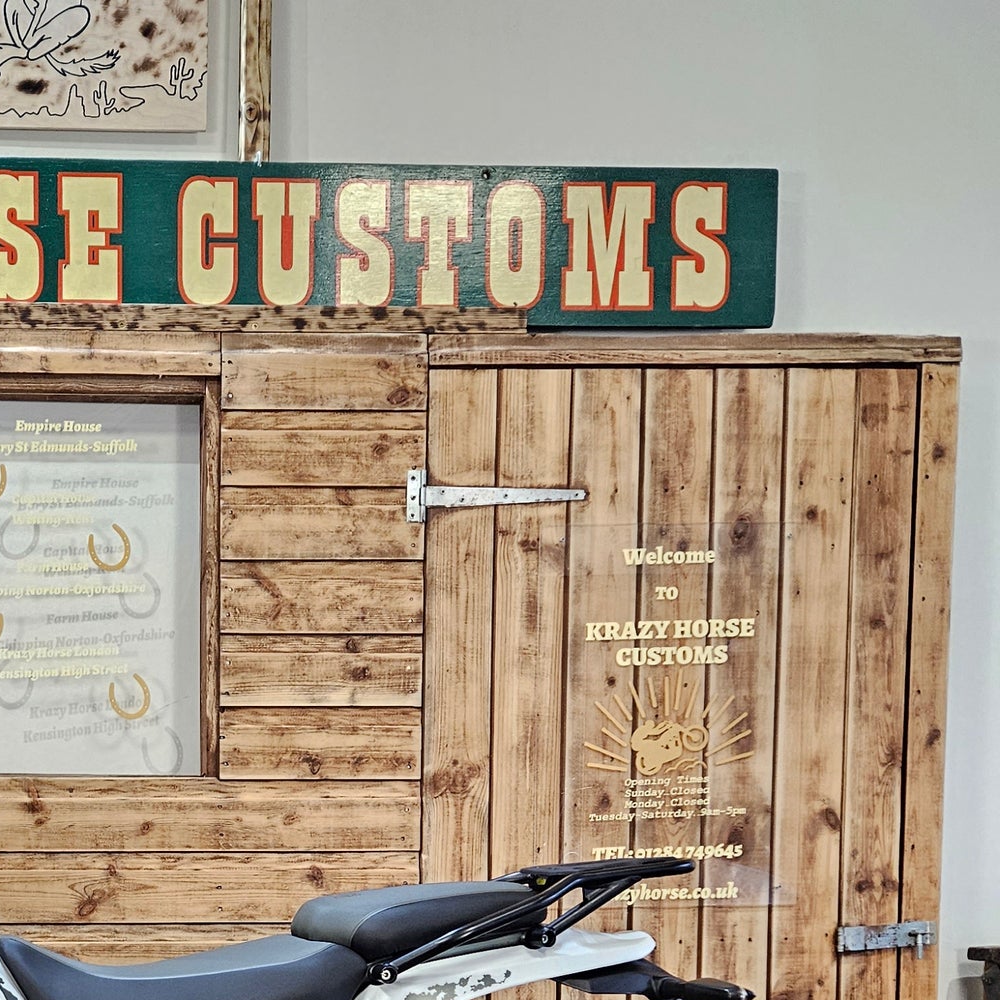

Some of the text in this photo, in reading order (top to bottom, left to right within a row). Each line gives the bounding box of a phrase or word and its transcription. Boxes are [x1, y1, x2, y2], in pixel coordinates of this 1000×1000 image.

[178, 176, 730, 312] CUSTOMS
[15, 420, 102, 435] Empire House
[15, 441, 28, 453] St
[30, 439, 137, 455] Edmunds-Suffolk
[622, 546, 716, 566] Welcome
[655, 586, 679, 600] TO
[585, 618, 756, 642] KRAZY HORSE
[615, 645, 728, 666] CUSTOMS
[60, 666, 90, 678] High
[92, 664, 129, 675] Street
[624, 775, 710, 788] Opening Times
[685, 843, 743, 860] 749645
[615, 881, 738, 906] zyhorse.co.uk
